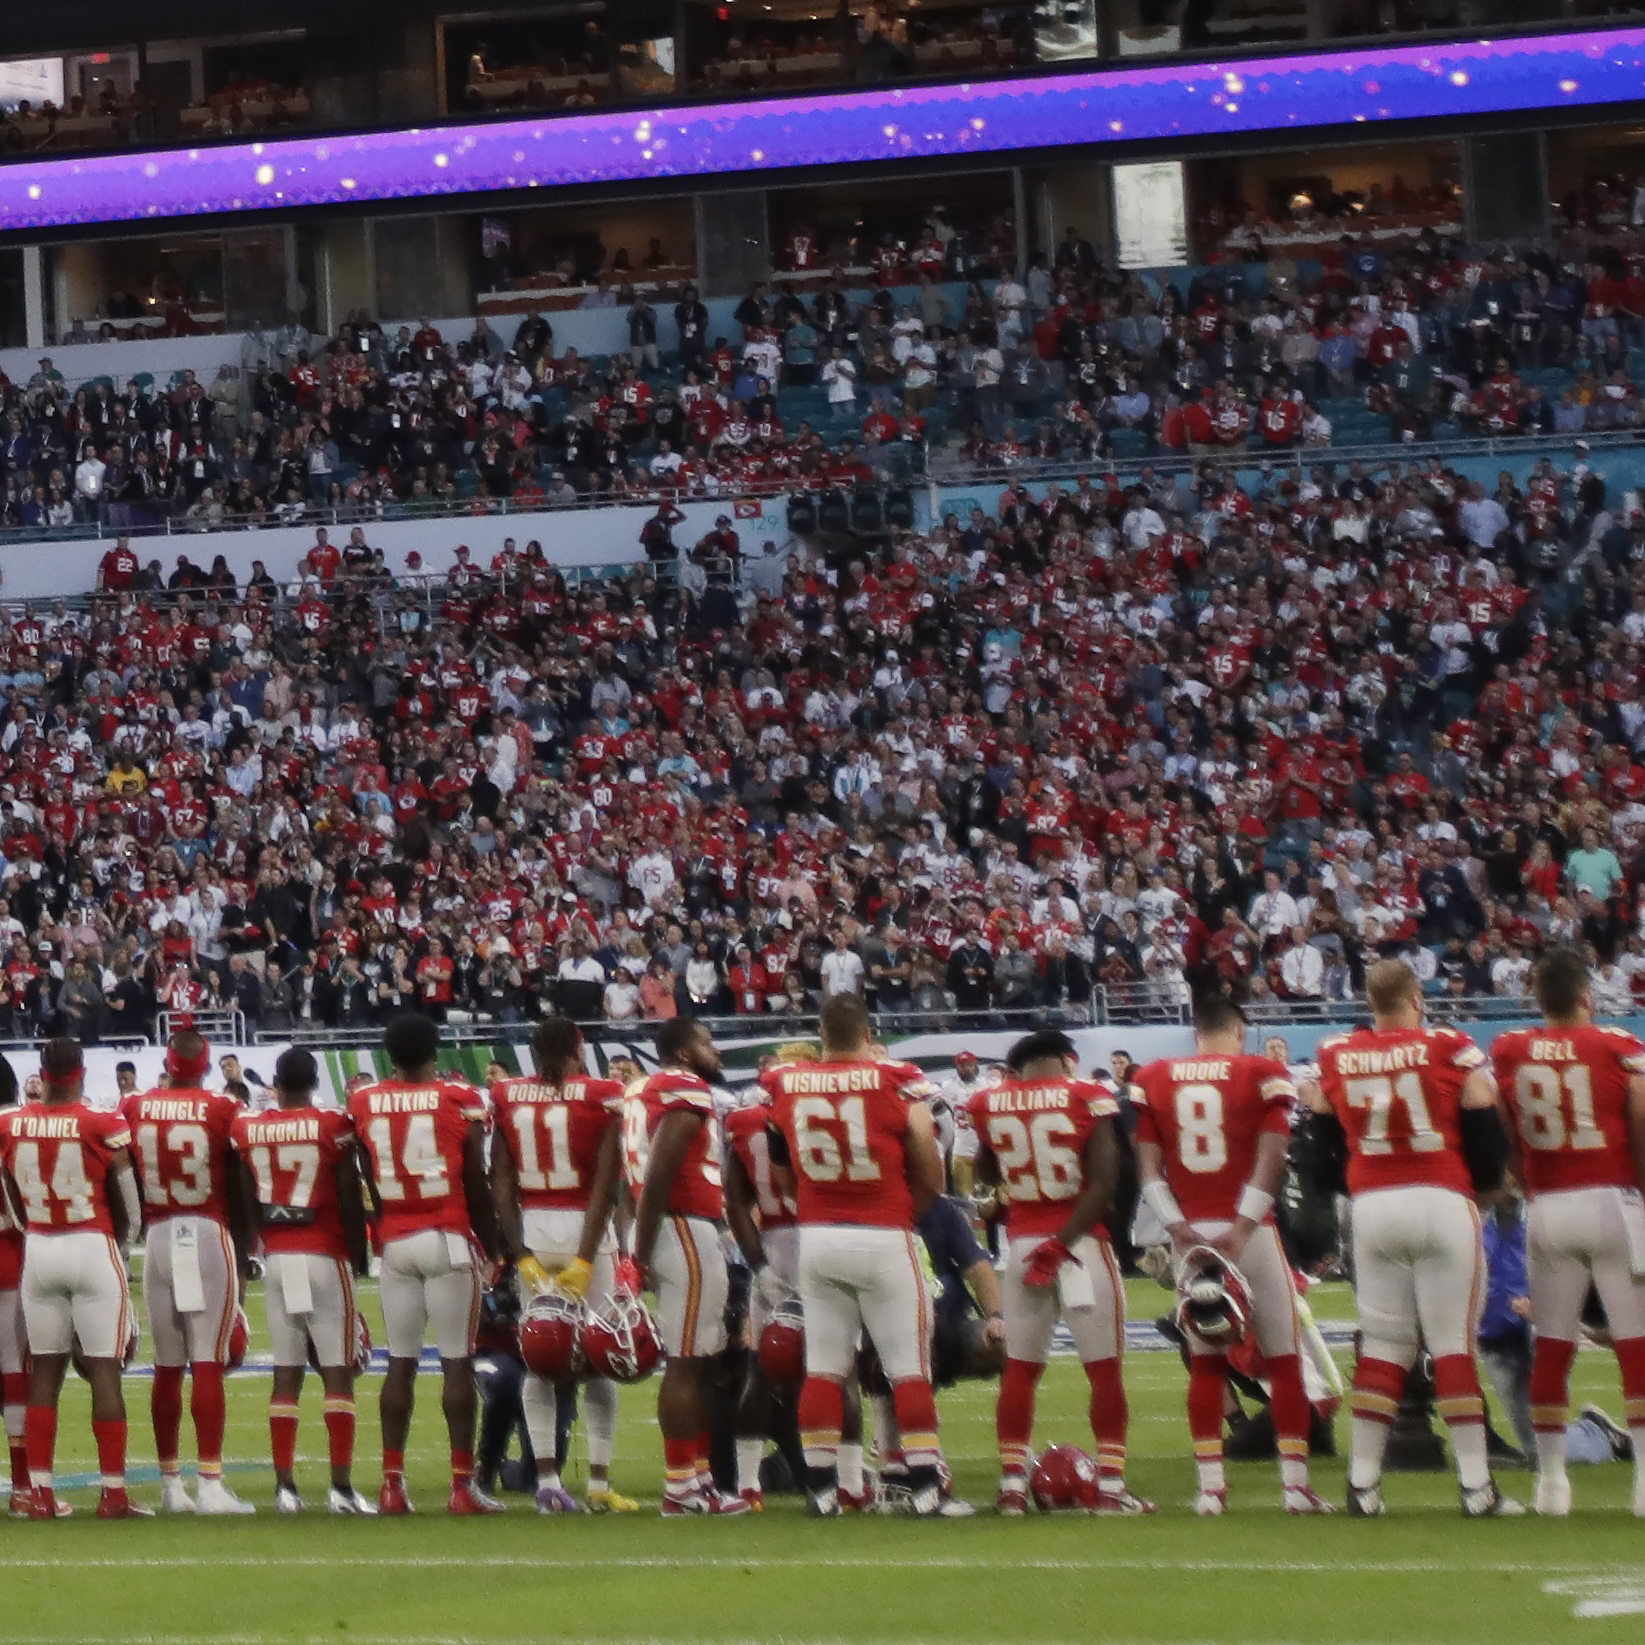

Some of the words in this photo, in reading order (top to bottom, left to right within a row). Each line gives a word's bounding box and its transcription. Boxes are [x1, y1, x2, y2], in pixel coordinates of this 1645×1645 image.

[117, 558, 134, 572] 22
[592, 787, 612, 806] 80
[1338, 1044, 1428, 1075] SCHWARTZ
[1530, 1040, 1577, 1061] BELL
[782, 1069, 881, 1093] WISNIEWSKI
[1172, 1060, 1230, 1081] MOORE
[140, 1099, 207, 1122] PRINGLE
[370, 1091, 439, 1112] WATKINS
[989, 1088, 1070, 1111] WILLIAMS
[1346, 1073, 1446, 1154] 71
[1515, 1064, 1607, 1151] 81
[11, 1116, 80, 1139] O'DANIEL
[247, 1121, 319, 1141] HARDMAN
[792, 1097, 881, 1182] 61
[1175, 1084, 1227, 1172] 8
[367, 1115, 449, 1199] 14
[512, 1105, 579, 1190] 11
[989, 1111, 1083, 1201] 26
[135, 1123, 212, 1208] 13
[250, 1146, 320, 1208] 17
[11, 1139, 96, 1224] 44
